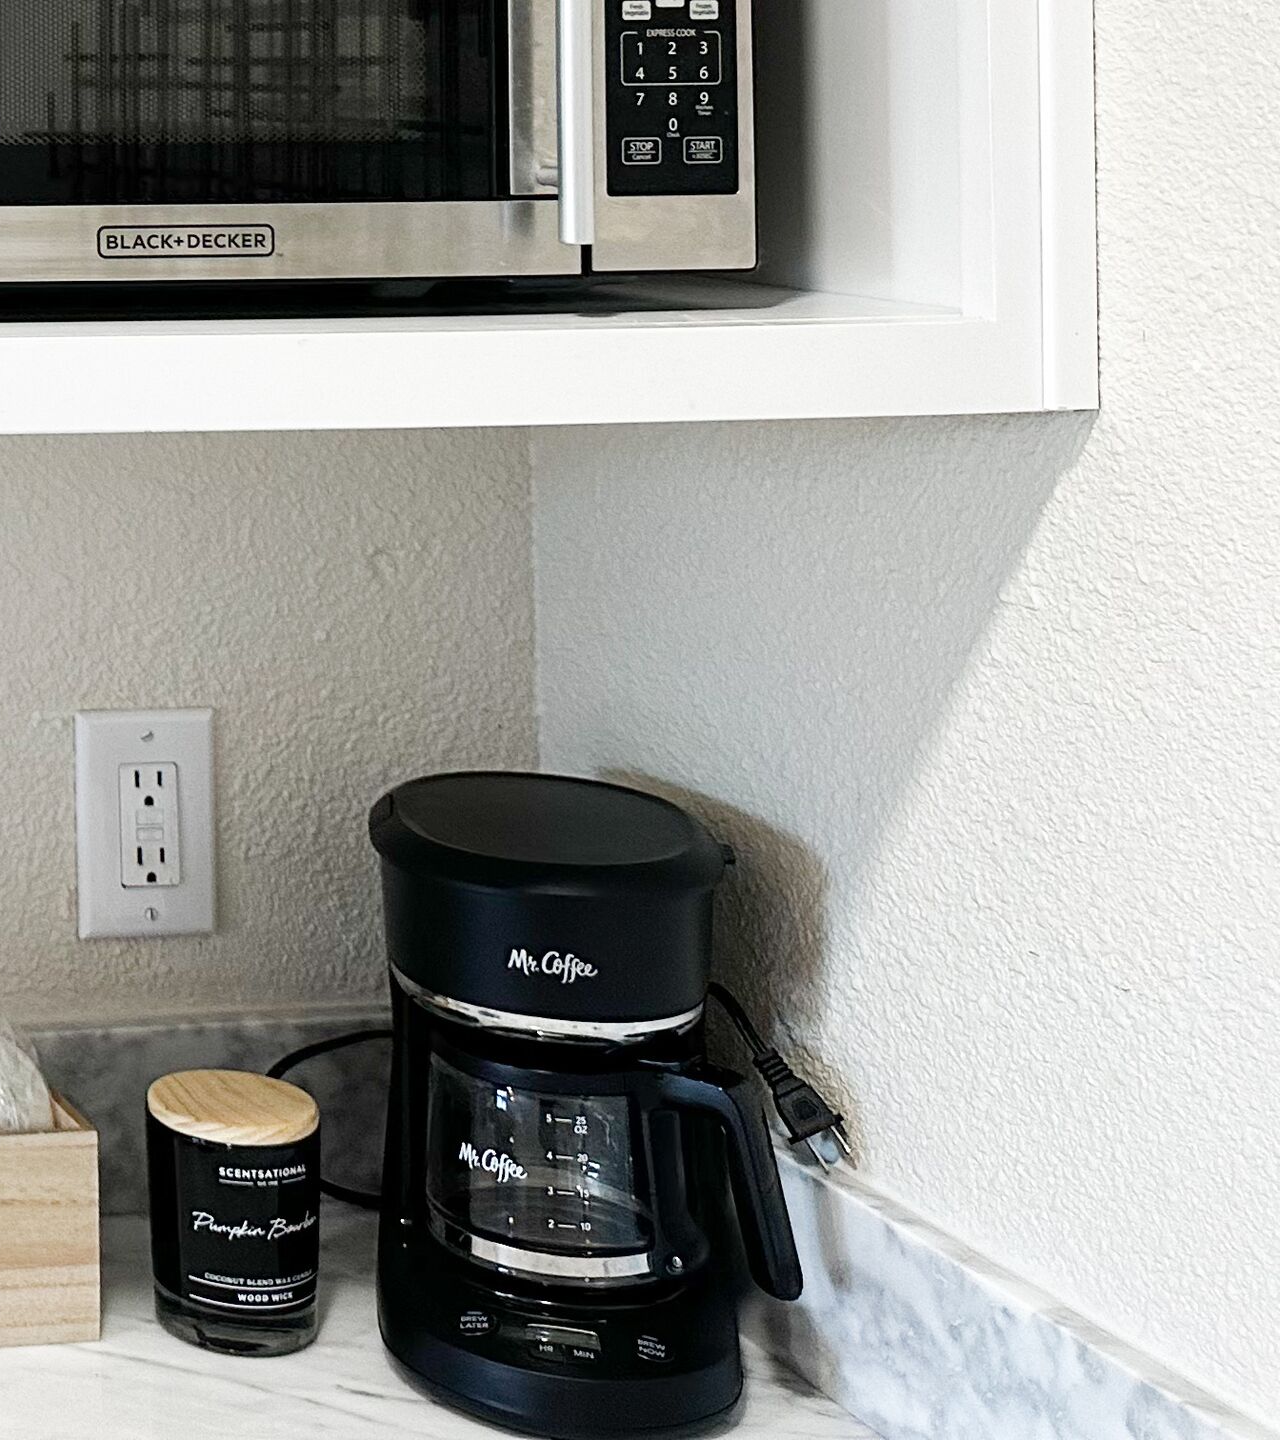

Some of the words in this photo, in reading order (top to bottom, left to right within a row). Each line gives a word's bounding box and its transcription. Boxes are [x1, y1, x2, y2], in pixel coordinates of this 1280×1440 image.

[646, 28, 675, 37] EXPRESS
[675, 28, 697, 37] COOK
[637, 42, 643, 55] 1
[668, 42, 677, 55] 2
[699, 41, 709, 55] 3
[635, 67, 645, 80] 4
[668, 66, 677, 79] 5
[699, 66, 709, 79] 6
[635, 92, 645, 106] 7
[668, 92, 678, 106] 8
[699, 91, 709, 105] 9
[668, 117, 678, 131] 0
[629, 141, 654, 151] STOP
[689, 140, 716, 151] START
[105, 233, 267, 250] BLACK+DECKER
[507, 948, 540, 976] Mr.
[541, 950, 599, 984] Coffee
[546, 1113, 553, 1123] 5
[575, 1116, 587, 1126] 25
[574, 1125, 588, 1135] OZ
[458, 1141, 481, 1170] Mr.
[481, 1148, 528, 1183] Coffee
[546, 1151, 553, 1160] 4
[576, 1153, 589, 1163] 20
[218, 1163, 307, 1180] SCENTSATIONAL
[547, 1186, 554, 1196] 3
[192, 1210, 266, 1241] Pumpkin
[548, 1219, 555, 1229] 2
[580, 1222, 592, 1232] 10
[204, 1271, 245, 1286] COCONUT
[246, 1278, 274, 1287] BLEND
[237, 1292, 270, 1303] WOOD
[271, 1291, 294, 1302] WICK
[539, 1344, 554, 1353] HR
[637, 1339, 666, 1351] BREW
[573, 1349, 595, 1359] MIN
[638, 1346, 666, 1358] NOW
